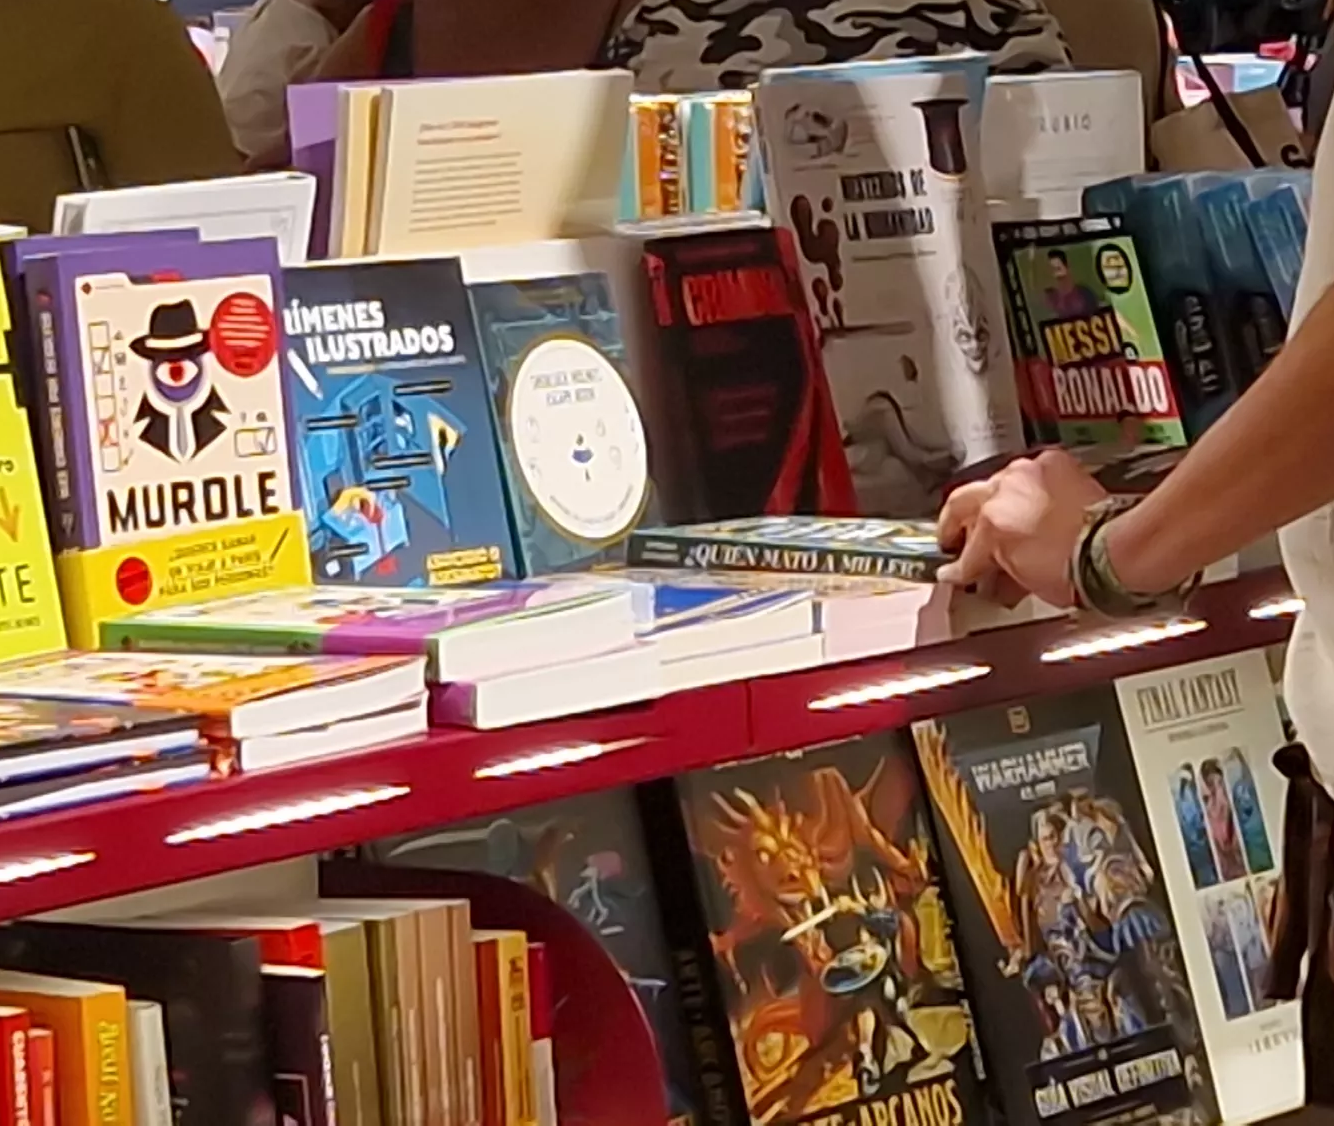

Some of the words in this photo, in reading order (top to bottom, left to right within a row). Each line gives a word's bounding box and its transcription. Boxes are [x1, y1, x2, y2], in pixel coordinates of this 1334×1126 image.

[304, 324, 455, 364] ILUSTRADOS
[1044, 312, 1123, 365] MESSI
[1052, 365, 1169, 416] RONALDO
[107, 470, 281, 534] MURDLE
[819, 554, 836, 573] A
[970, 741, 1093, 794] WARHAMMER
